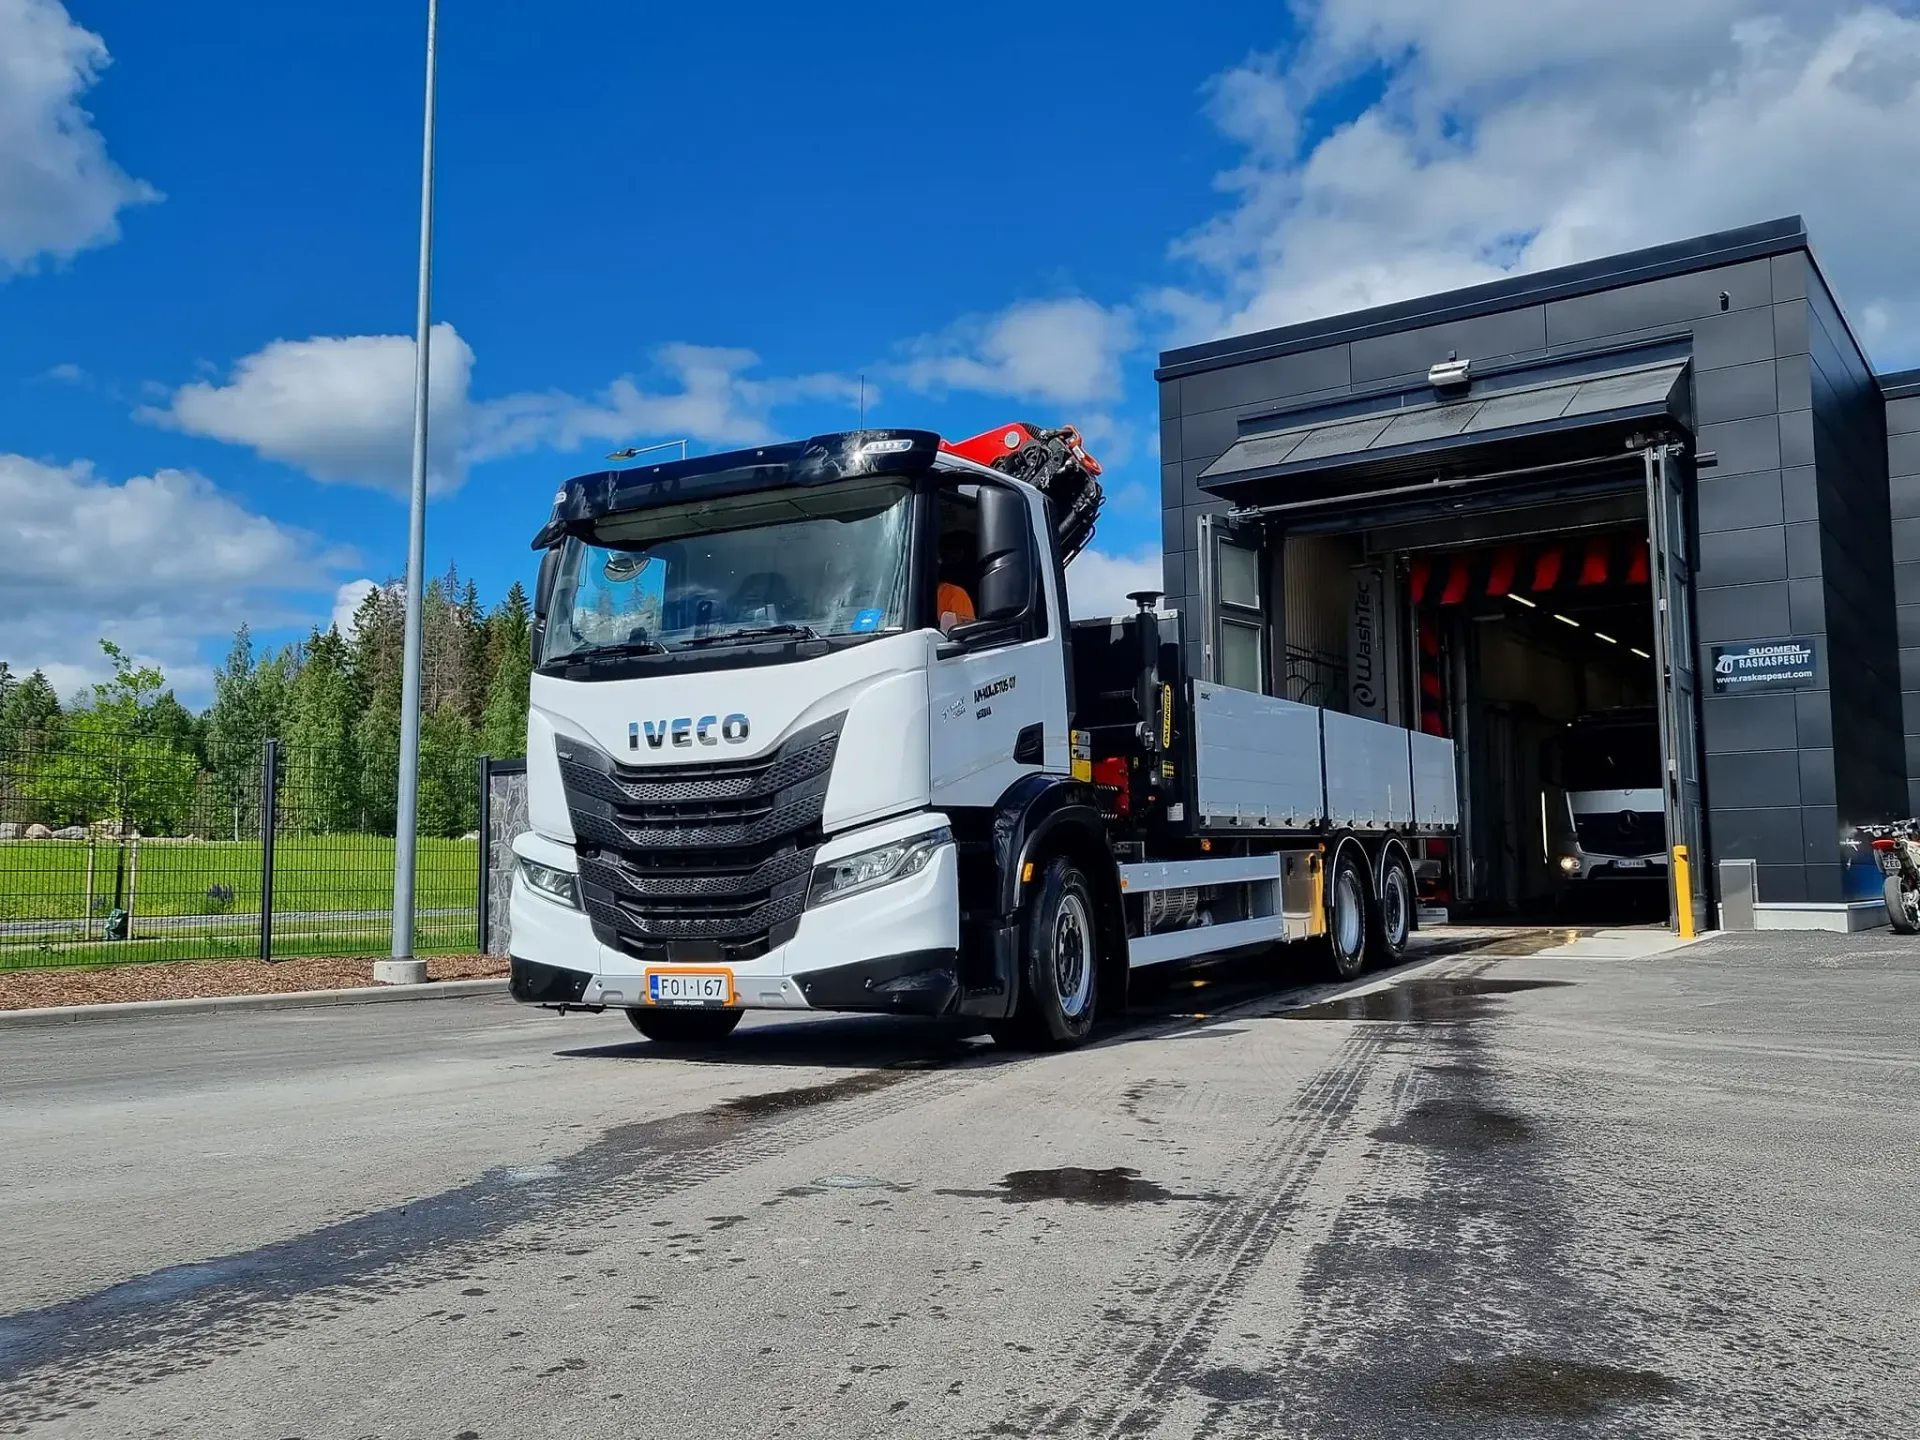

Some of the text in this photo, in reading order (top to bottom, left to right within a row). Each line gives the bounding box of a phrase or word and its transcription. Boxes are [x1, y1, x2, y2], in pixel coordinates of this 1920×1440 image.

[1355, 581, 1372, 682] WashTec
[1748, 645, 1800, 656] SUOMEN
[1738, 654, 1809, 668] RASKASPESUT
[1716, 670, 1812, 683] www.raskaspesut.com
[628, 713, 751, 751] IVECO
[661, 979, 722, 996] FOI-167
